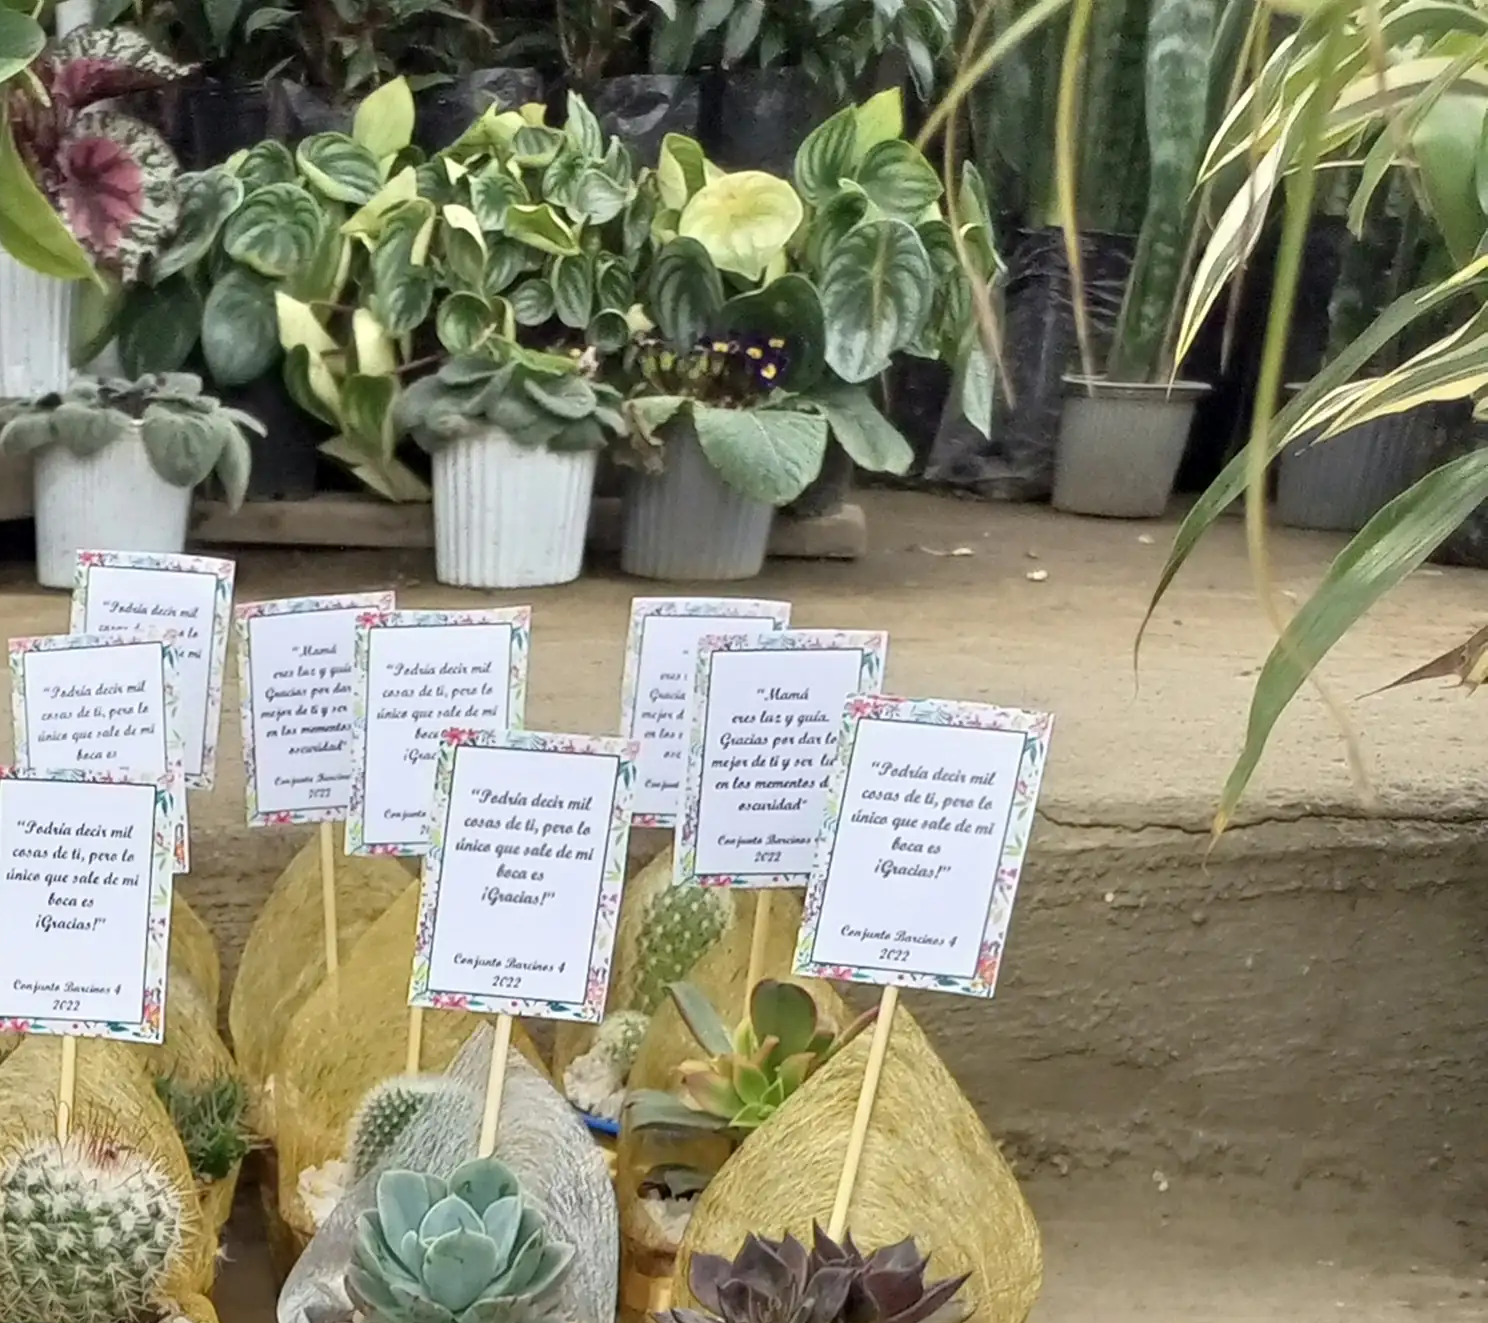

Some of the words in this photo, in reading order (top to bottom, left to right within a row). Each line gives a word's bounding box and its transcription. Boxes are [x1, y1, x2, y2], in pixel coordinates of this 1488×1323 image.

[931, 766, 967, 783] decir
[969, 771, 997, 786] mil
[860, 788, 900, 802] cosas
[903, 788, 922, 804] de
[923, 791, 939, 808] ti,
[940, 796, 974, 811] pero
[977, 795, 993, 811] lo
[850, 808, 888, 825] único
[891, 816, 919, 831] que
[920, 815, 952, 832] sale
[953, 817, 972, 834] de
[973, 822, 995, 835] mi
[890, 835, 924, 853] boca
[926, 844, 941, 855] es
[840, 924, 891, 942] Conjunto
[893, 929, 945, 946] Barcinos
[948, 935, 958, 948] 4
